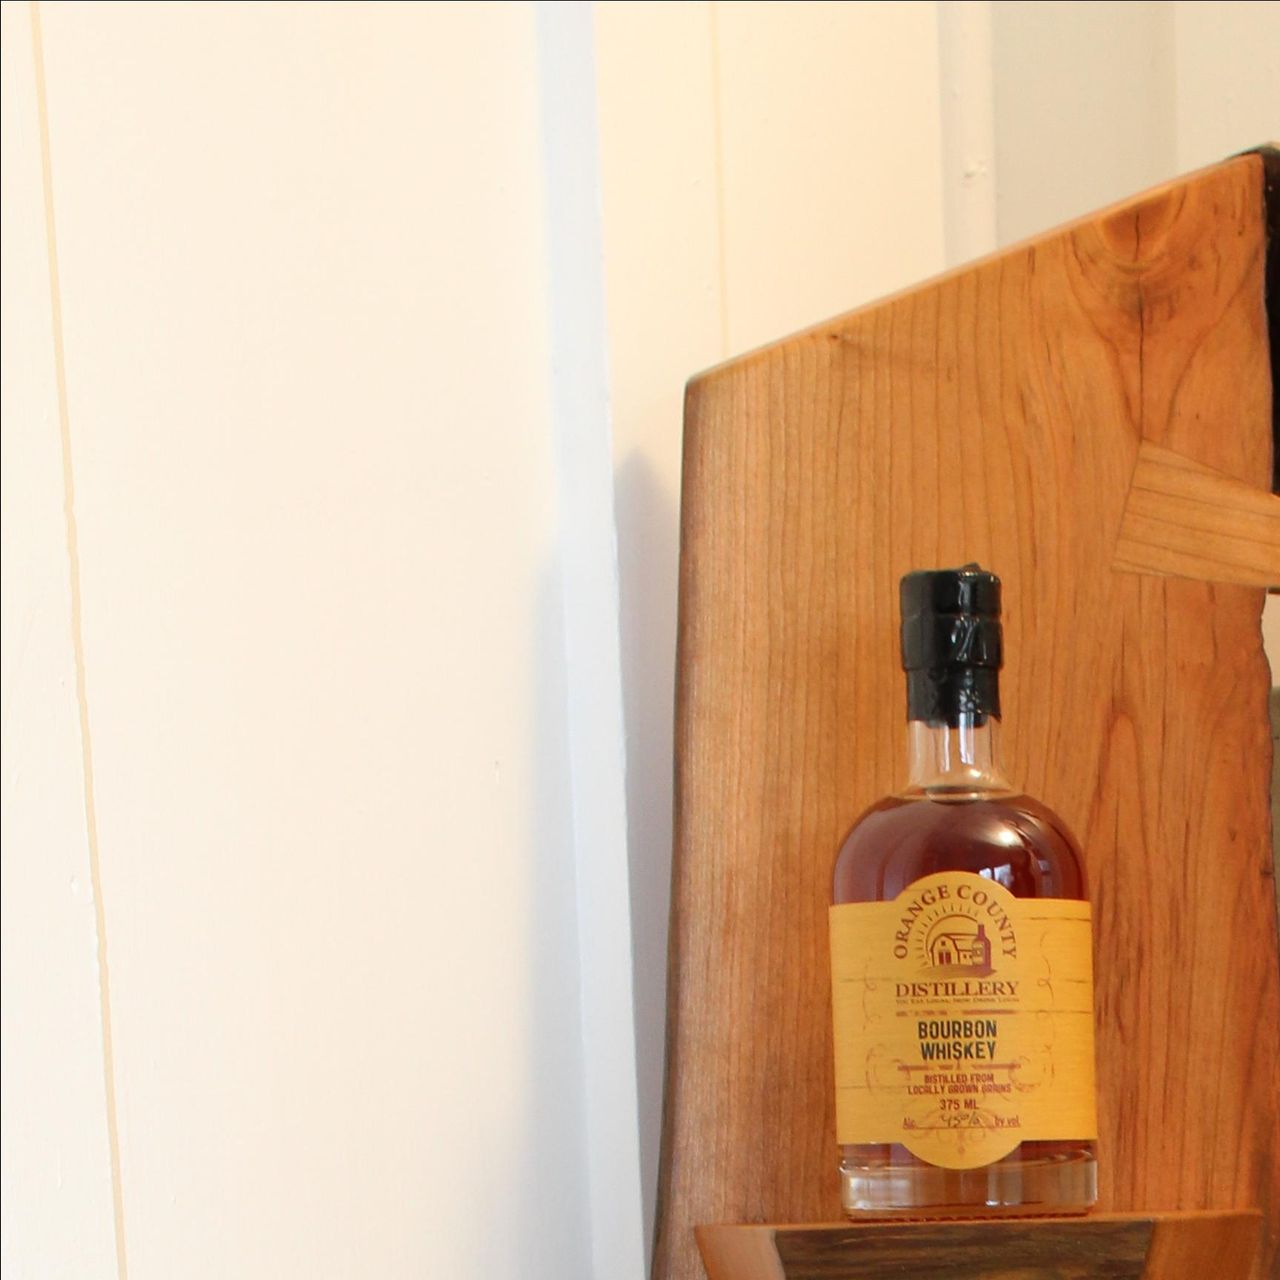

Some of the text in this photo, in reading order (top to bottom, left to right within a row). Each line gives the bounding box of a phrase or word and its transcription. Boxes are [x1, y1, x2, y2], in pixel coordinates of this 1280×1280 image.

[893, 884, 1017, 960] ORANGE COUNTY
[896, 981, 1019, 998] DISTILLERY
[918, 1020, 997, 1039] BOURBON
[920, 1041, 996, 1060] WHISKEY
[924, 1073, 994, 1084] DISTILLED FROM
[908, 1085, 946, 1095] LOCALLY
[948, 1084, 979, 1094] GROWN
[939, 1098, 979, 1110] 375 ML
